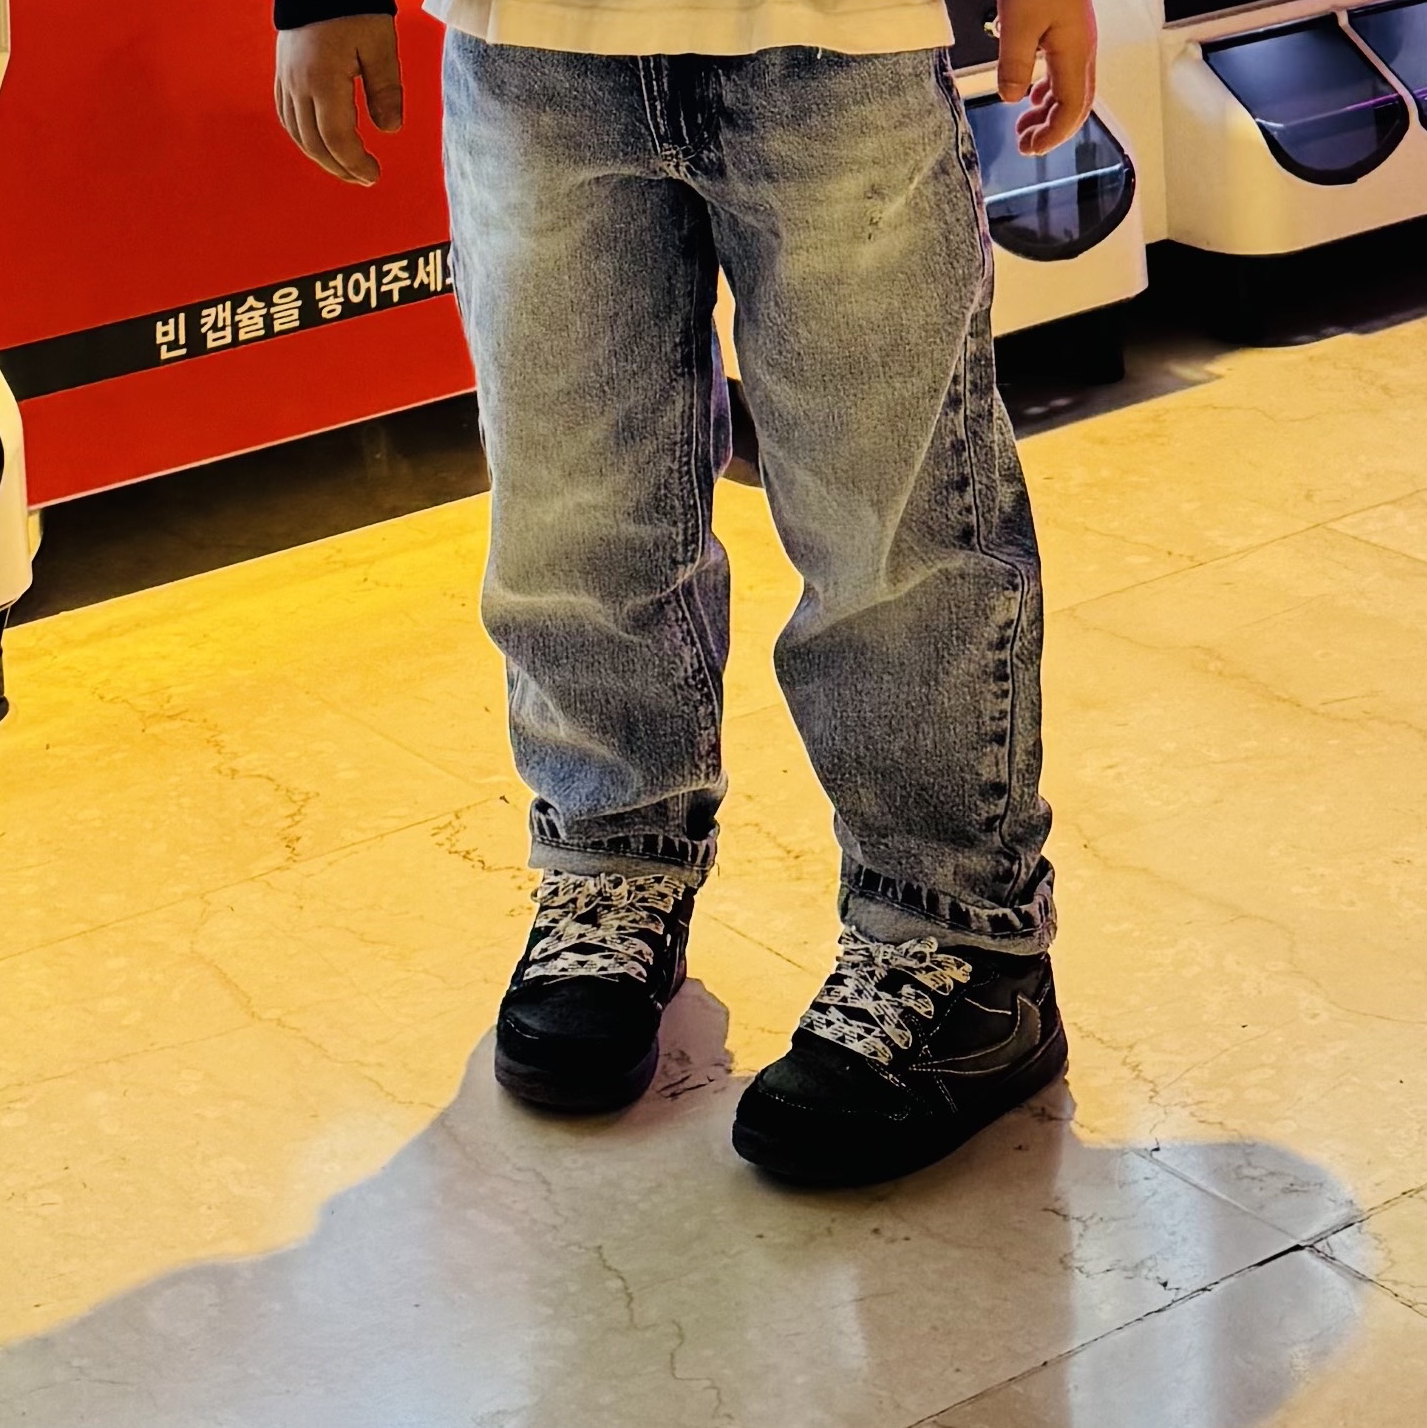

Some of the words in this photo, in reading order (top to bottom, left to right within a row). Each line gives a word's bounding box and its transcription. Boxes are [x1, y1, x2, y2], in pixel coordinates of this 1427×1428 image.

[155, 312, 188, 361] 빈
[200, 285, 302, 349] 캡슐을
[314, 248, 455, 323] 넣어주세
